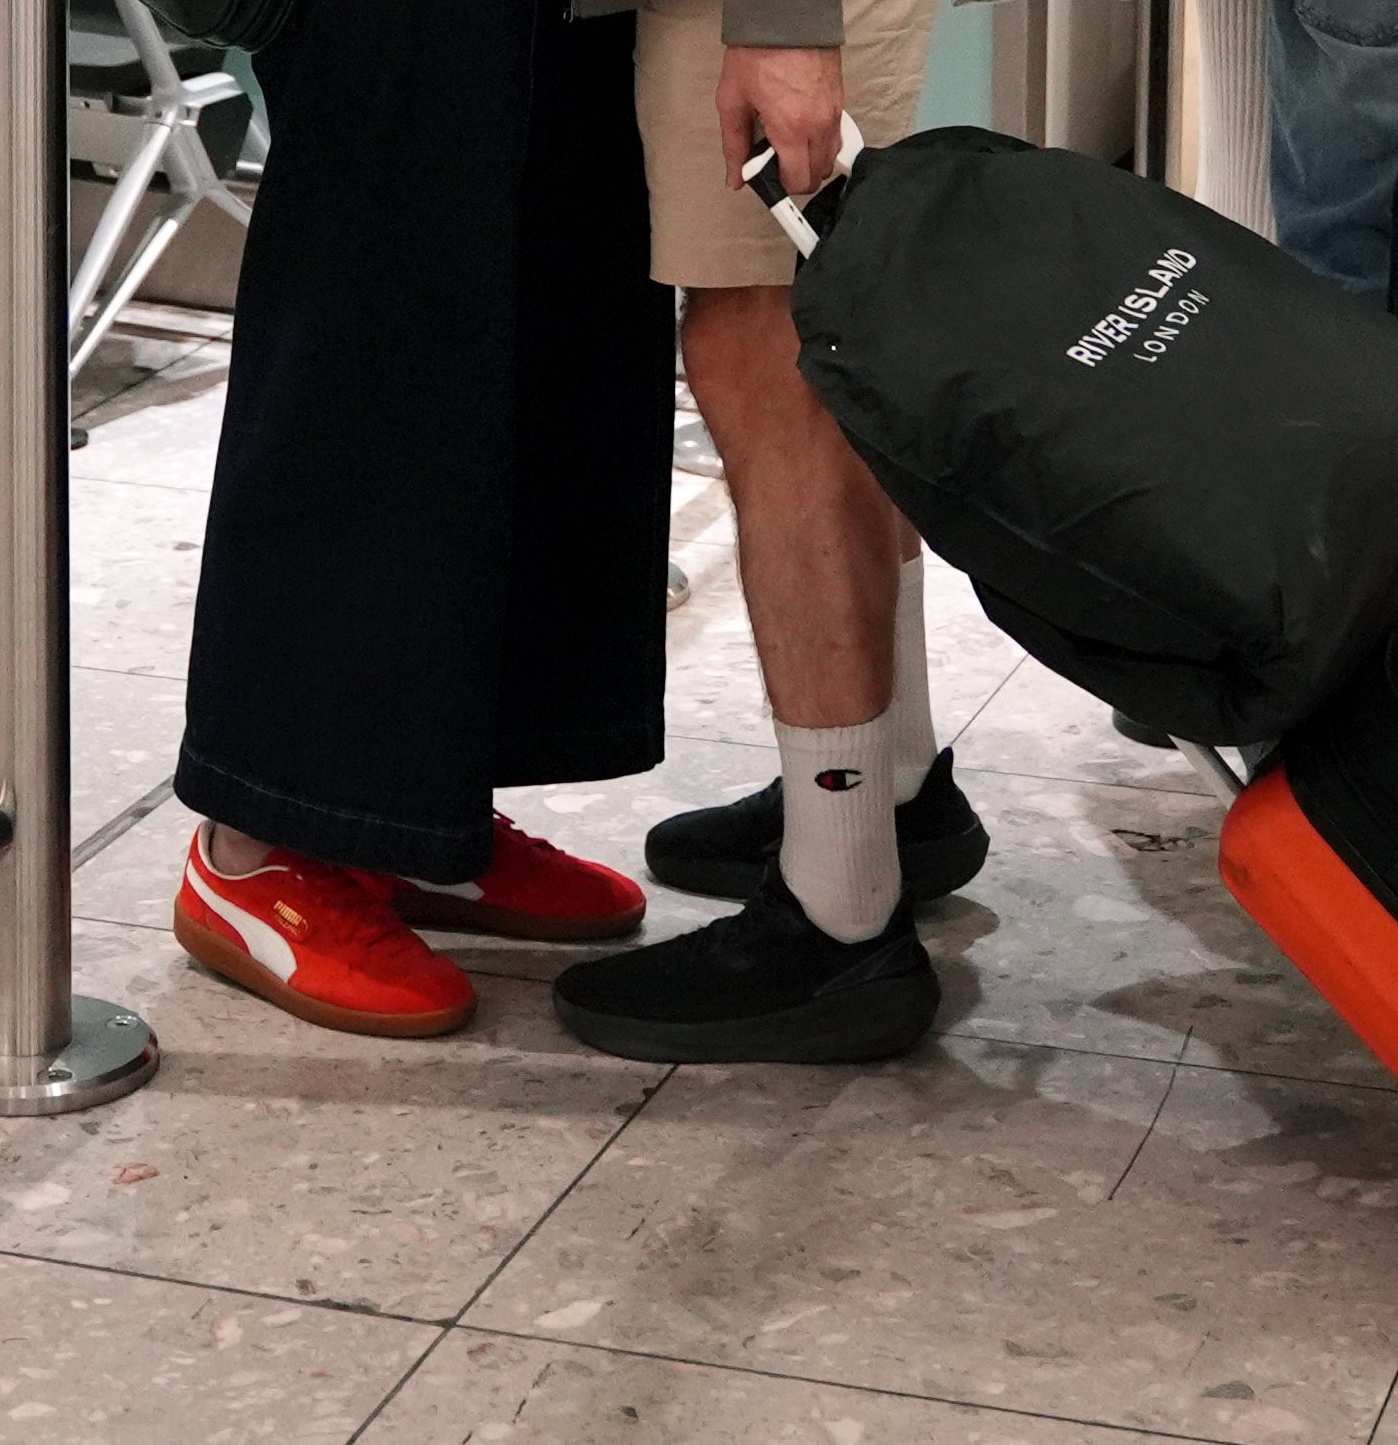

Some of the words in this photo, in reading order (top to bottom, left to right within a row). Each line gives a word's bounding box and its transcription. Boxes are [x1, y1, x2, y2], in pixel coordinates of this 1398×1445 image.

[1066, 313, 1139, 367] RIVER
[1118, 248, 1197, 319] ISLAND
[1133, 289, 1210, 363] LONDON
[273, 900, 302, 926] PUMA
